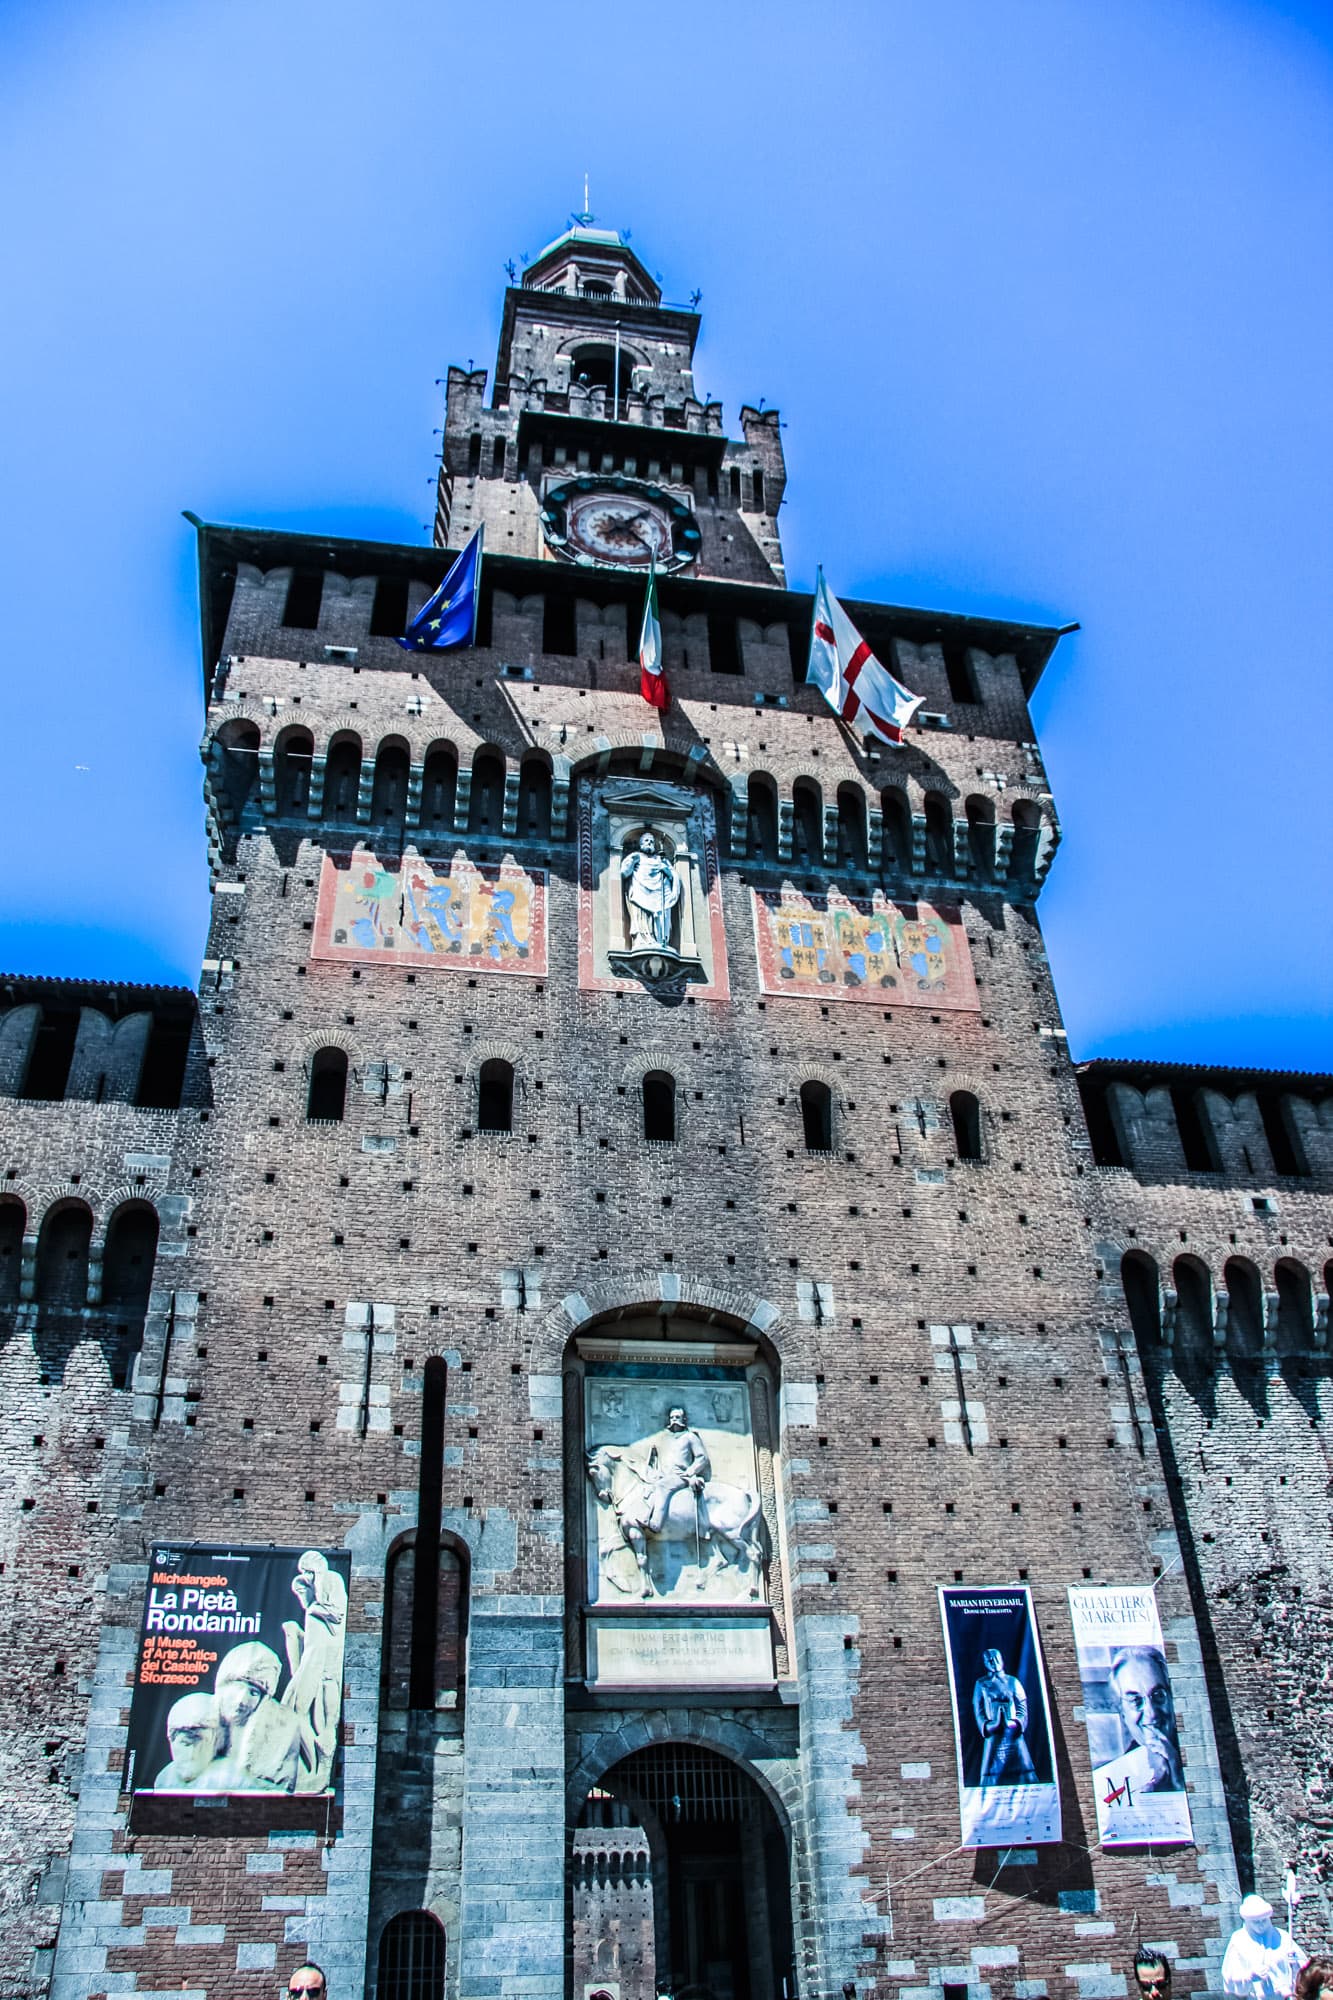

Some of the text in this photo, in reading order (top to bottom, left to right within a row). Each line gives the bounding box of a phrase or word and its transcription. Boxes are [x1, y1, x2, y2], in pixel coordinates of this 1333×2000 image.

[152, 1572, 228, 1588] Michelangelo
[149, 1588, 238, 1611] La Pietà
[949, 1598, 1024, 1607] MARIAN HEYERDAHL
[1073, 1595, 1153, 1609] GUALTIERO
[146, 1609, 262, 1633] Rondanini
[1081, 1610, 1151, 1623] MARCHESI
[144, 1636, 197, 1649] al Museo
[143, 1648, 217, 1661] d'Arte Antica
[141, 1660, 209, 1673] del Castello
[140, 1671, 199, 1685] Sforzesco
